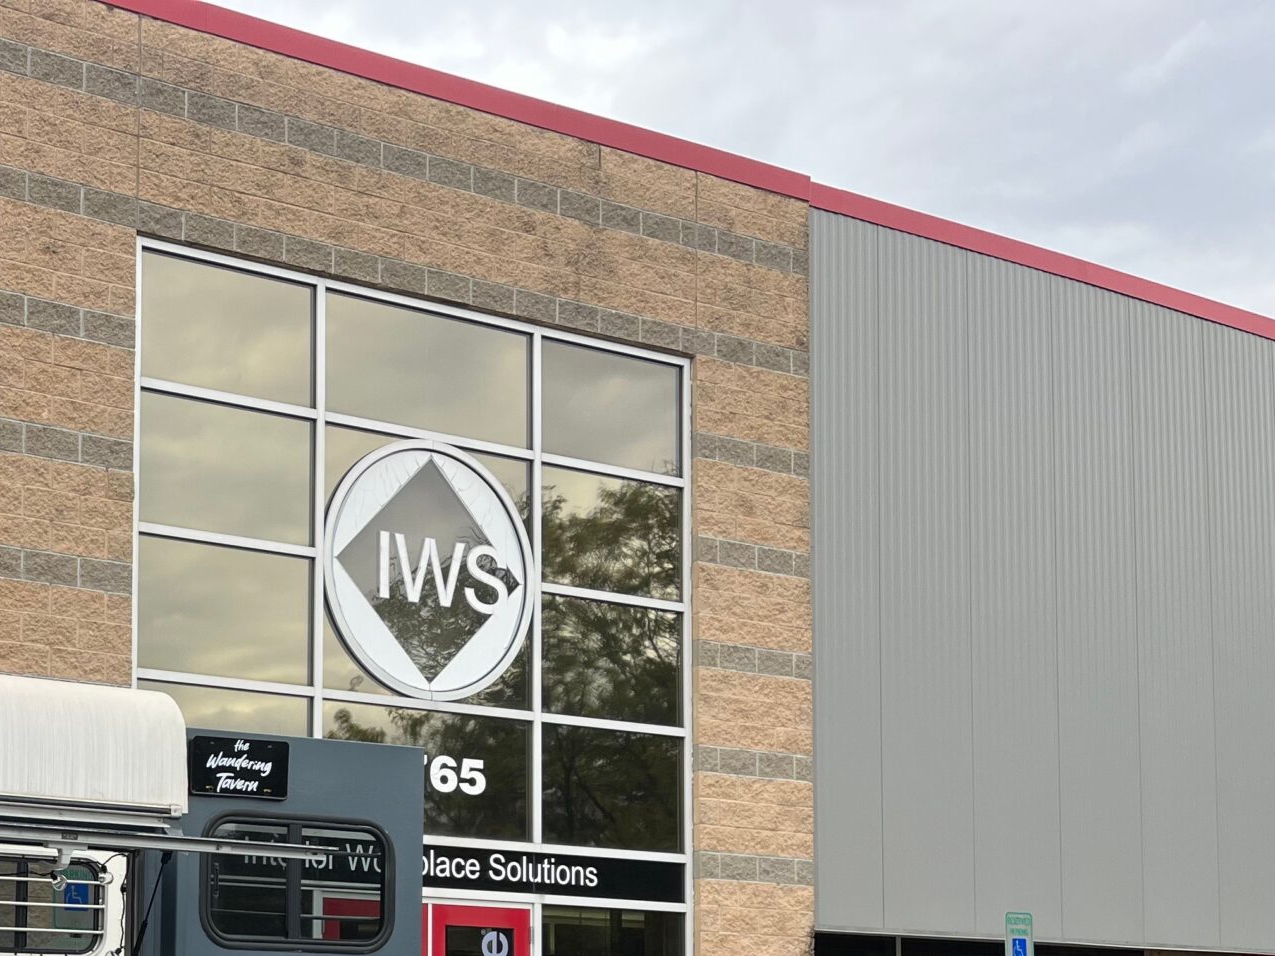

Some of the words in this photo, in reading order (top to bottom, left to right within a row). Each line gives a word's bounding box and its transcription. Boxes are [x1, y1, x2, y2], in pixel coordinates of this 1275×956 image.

[378, 530, 509, 616] IWS
[233, 739, 250, 753] the
[206, 751, 273, 777] Wandering
[423, 754, 487, 796] 65
[215, 772, 259, 793] Tavern
[488, 853, 598, 887] Solutions
